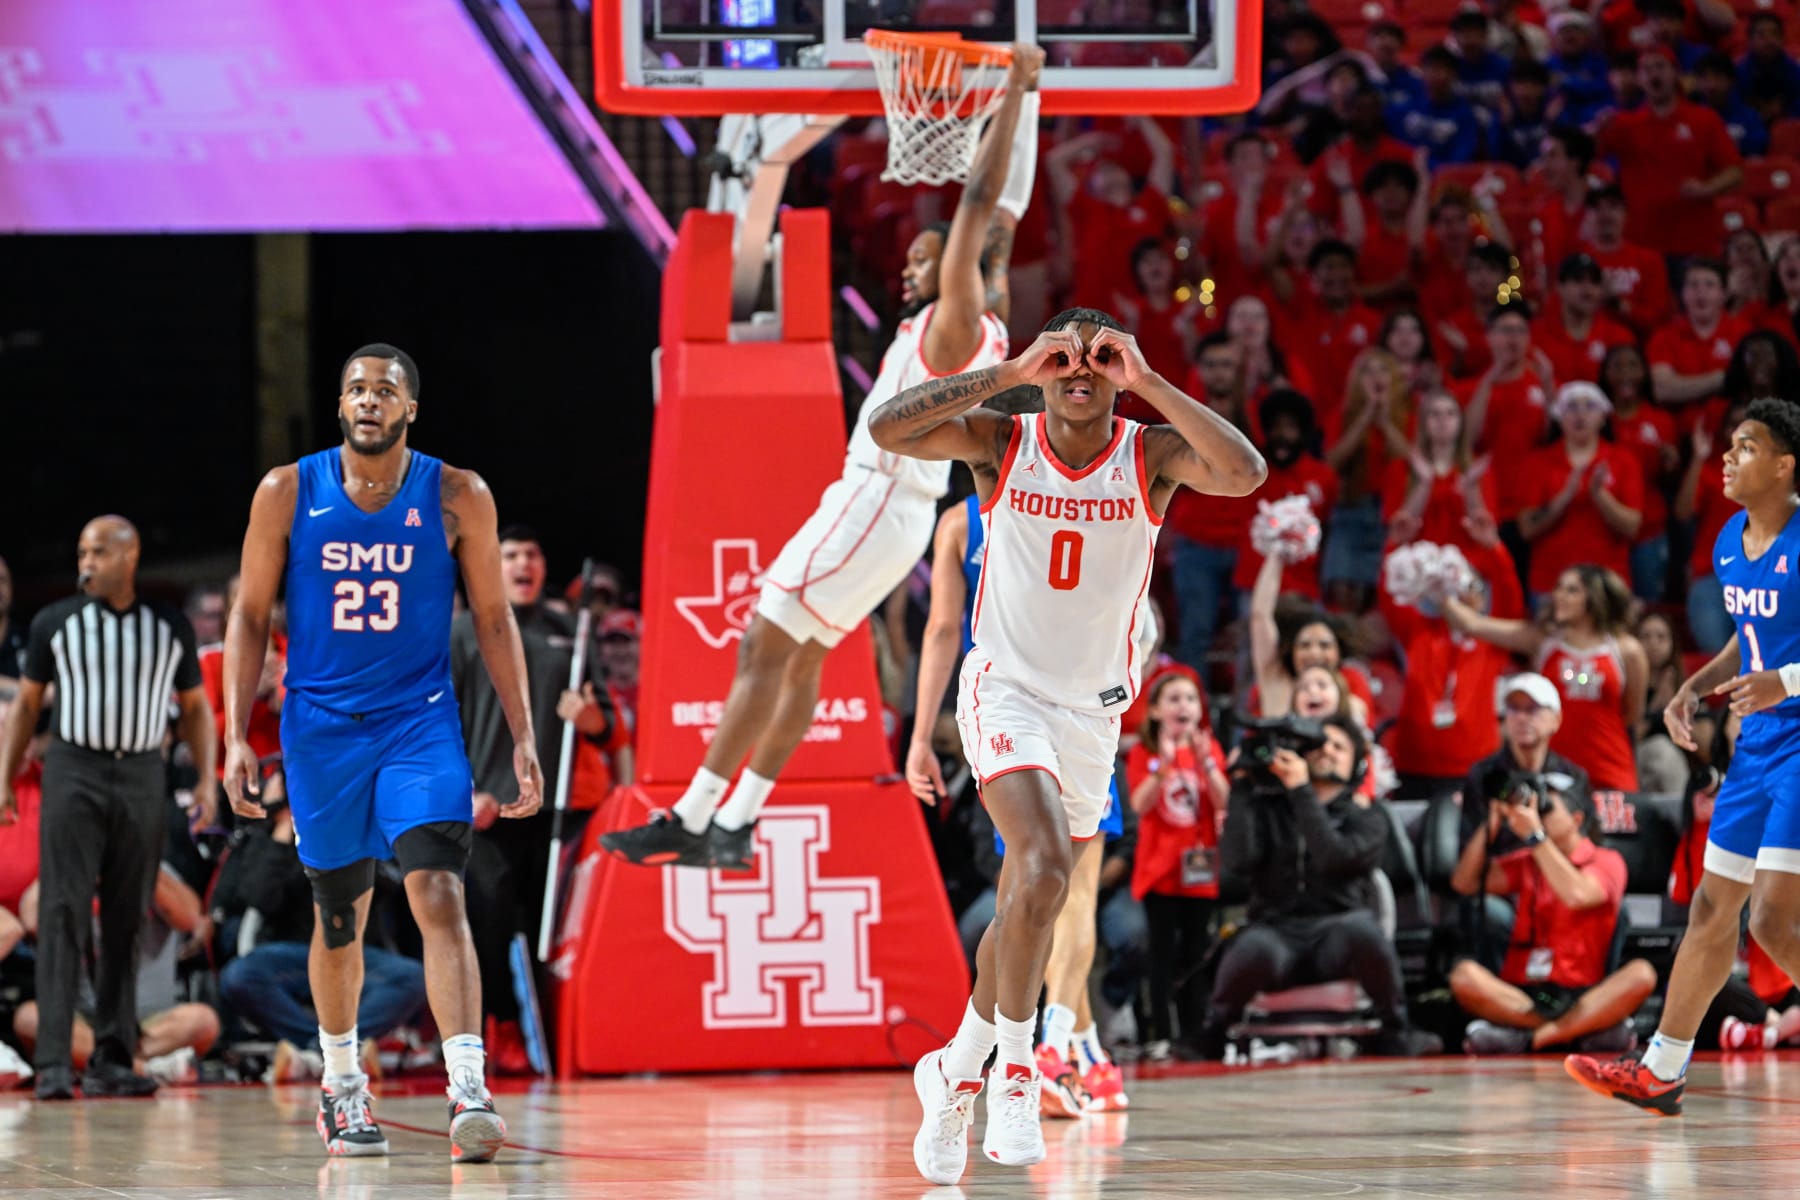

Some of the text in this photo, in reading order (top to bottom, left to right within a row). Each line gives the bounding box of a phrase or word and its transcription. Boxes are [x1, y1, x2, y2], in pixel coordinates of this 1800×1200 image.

[1010, 488, 1136, 522] HOUSTON
[322, 541, 415, 573] SMU
[1048, 529, 1084, 590] 0
[332, 579, 400, 632] 23
[1723, 584, 1779, 618] SMU
[1743, 621, 1764, 672] 1
[672, 698, 867, 726] BES XAS
[662, 805, 884, 1030] UH
